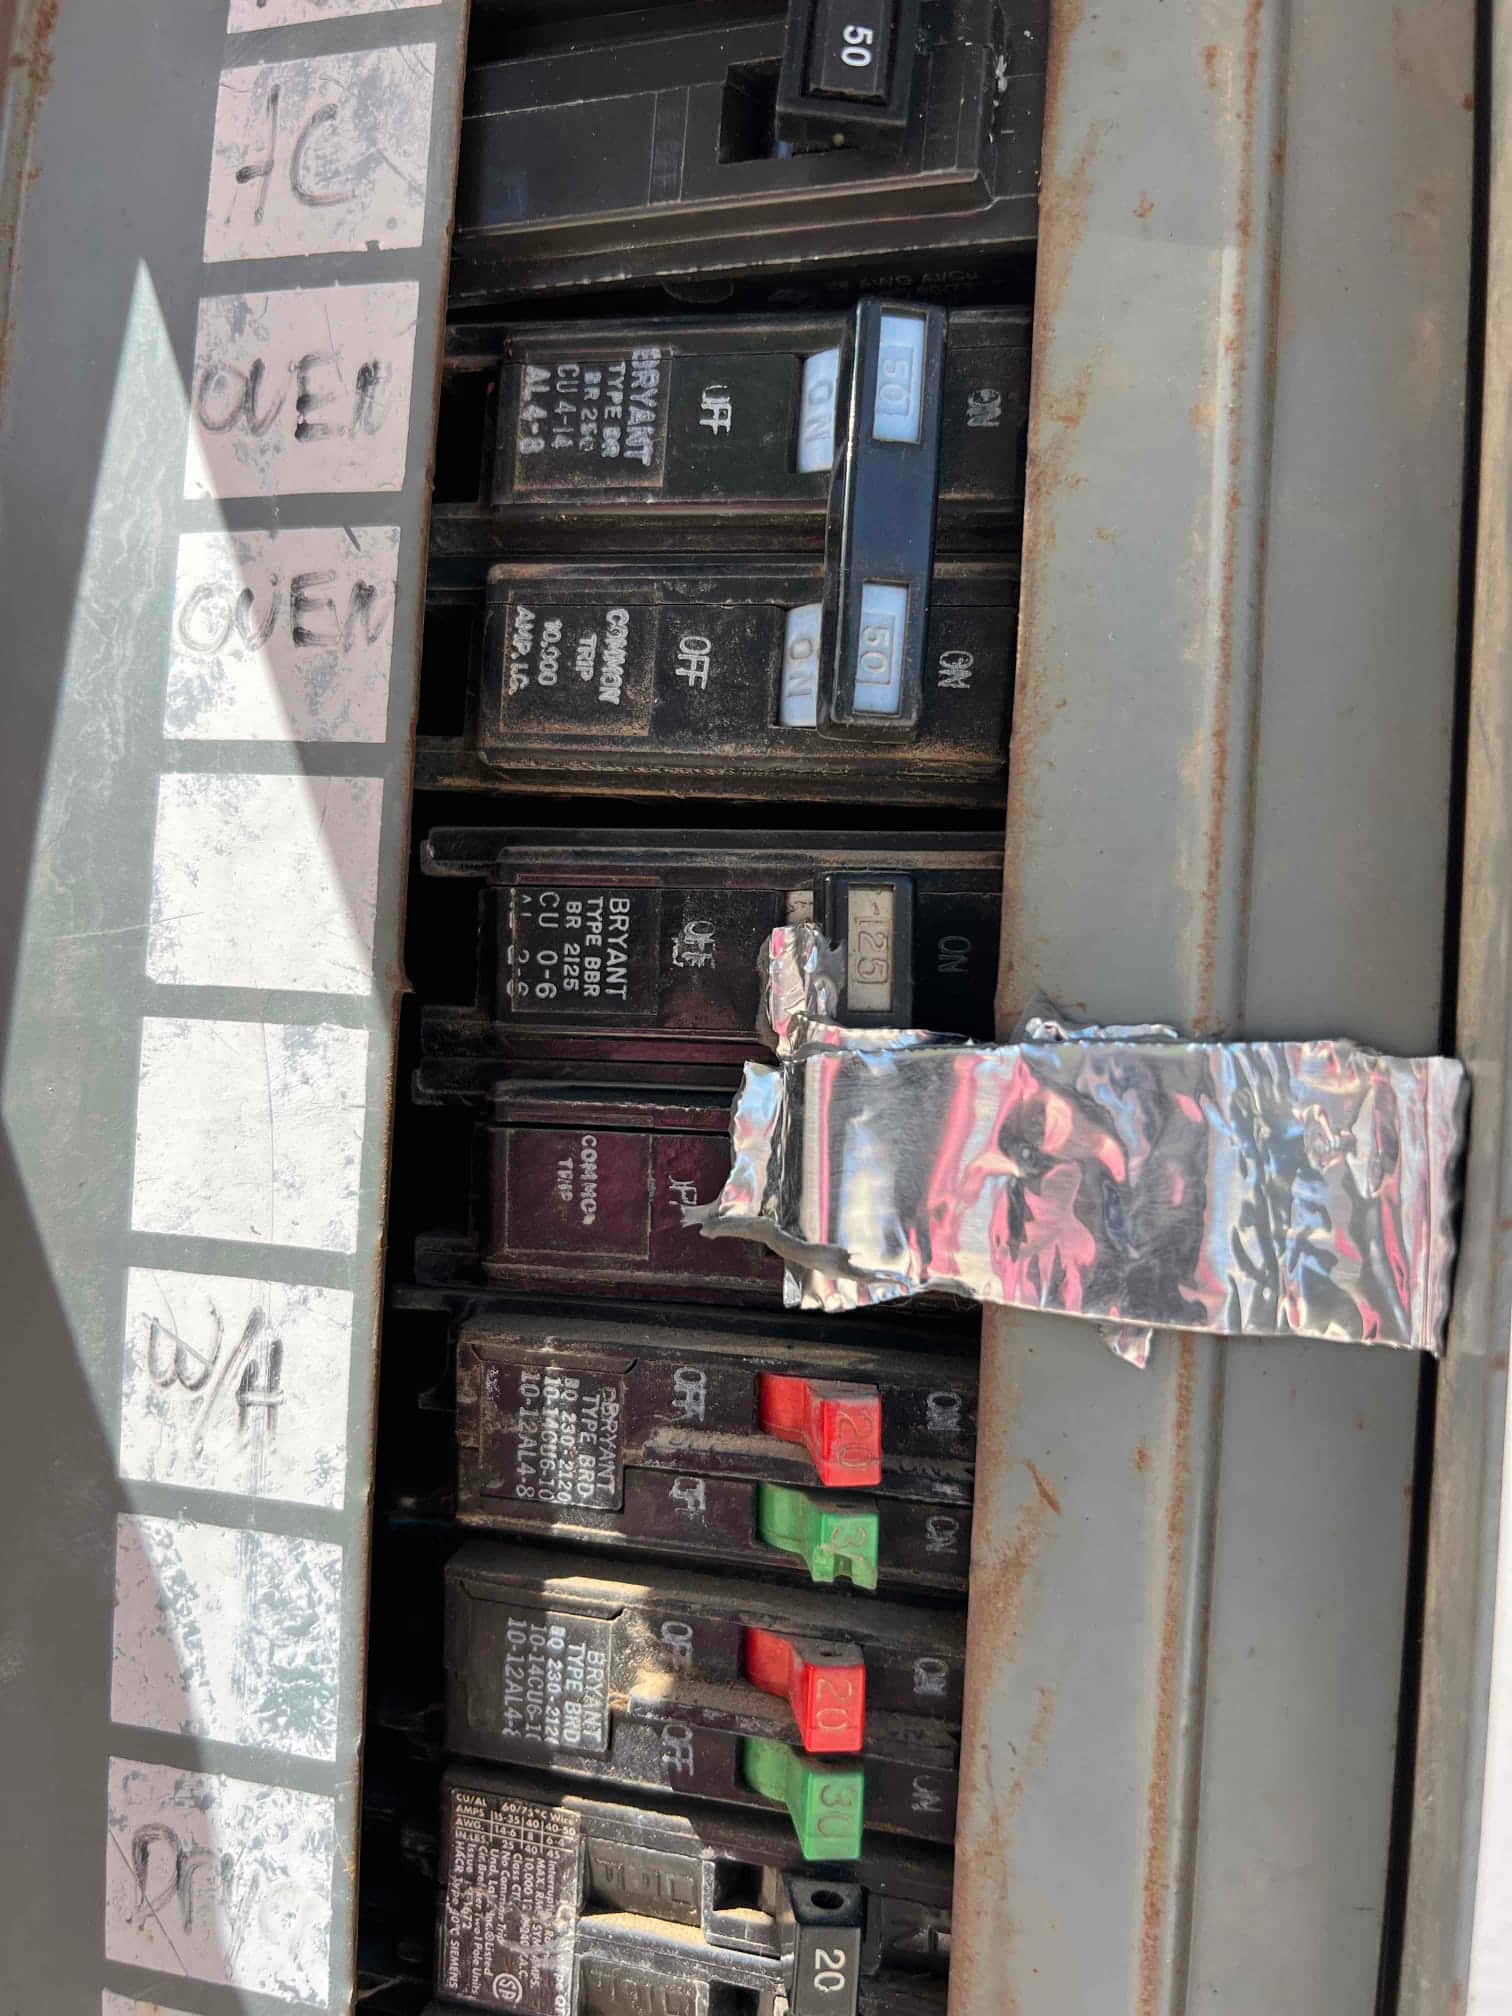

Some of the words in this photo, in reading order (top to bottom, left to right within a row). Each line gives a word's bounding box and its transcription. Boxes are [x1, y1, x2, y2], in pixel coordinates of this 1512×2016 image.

[840, 25, 876, 67] 50
[522, 365, 552, 401] AL
[556, 363, 581, 394] CU
[584, 371, 602, 401] BR
[604, 361, 626, 419] TYPE
[879, 359, 910, 403] 50
[550, 400, 577, 450] 4-14
[622, 347, 663, 467] BRYANT
[804, 381, 835, 442] ON
[575, 633, 597, 682] TRIP
[598, 608, 630, 705] COMMON
[675, 635, 712, 690] OFF
[785, 639, 814, 698] ON
[860, 624, 890, 674] 50
[936, 650, 974, 689] ON
[538, 891, 561, 928] CU
[565, 900, 583, 929] BR
[584, 896, 604, 947] TYPE
[563, 943, 581, 991] 2125
[605, 897, 631, 1001] BRYANT
[936, 935, 972, 975] ON
[534, 949, 559, 999] 0-6
[583, 956, 602, 997] BBR
[671, 1367, 707, 1422] OFF
[579, 1393, 601, 1445] TYPE
[837, 1409, 873, 1470] 20
[556, 1409, 577, 1504] 230-2120
[576, 1454, 596, 1498] BRD
[925, 1515, 960, 1554] ON
[565, 1642, 587, 1693] TYPE
[583, 1649, 606, 1744] BRYANT
[816, 1678, 853, 1731] 20
[562, 1700, 582, 1743] BRD
[661, 1723, 694, 1776] OFF
[456, 1793, 487, 1807] CU/AL
[456, 1804, 485, 1817] AMPS
[494, 1811, 520, 1824] 15-35
[525, 1818, 540, 1829] 40
[545, 1822, 576, 1836] 40-50
[817, 1783, 855, 1838] 30
[456, 1818, 485, 1831] AWG.
[495, 1825, 517, 1837] 14-6
[527, 1831, 534, 1841] 8
[501, 1839, 515, 1850] 25
[524, 1845, 538, 1855] 40
[547, 1849, 560, 1860] 45
[454, 1840, 466, 1873] HACR
[466, 1843, 476, 1873] Issue
[501, 1850, 511, 1867] No
[512, 1853, 523, 1881] Class
[523, 1858, 535, 1895] 10,000
[448, 1939, 461, 1989] SIEMENS
[472, 1942, 484, 1967] Pole
[813, 1948, 847, 1993] 20
[470, 1967, 483, 1995] Units
